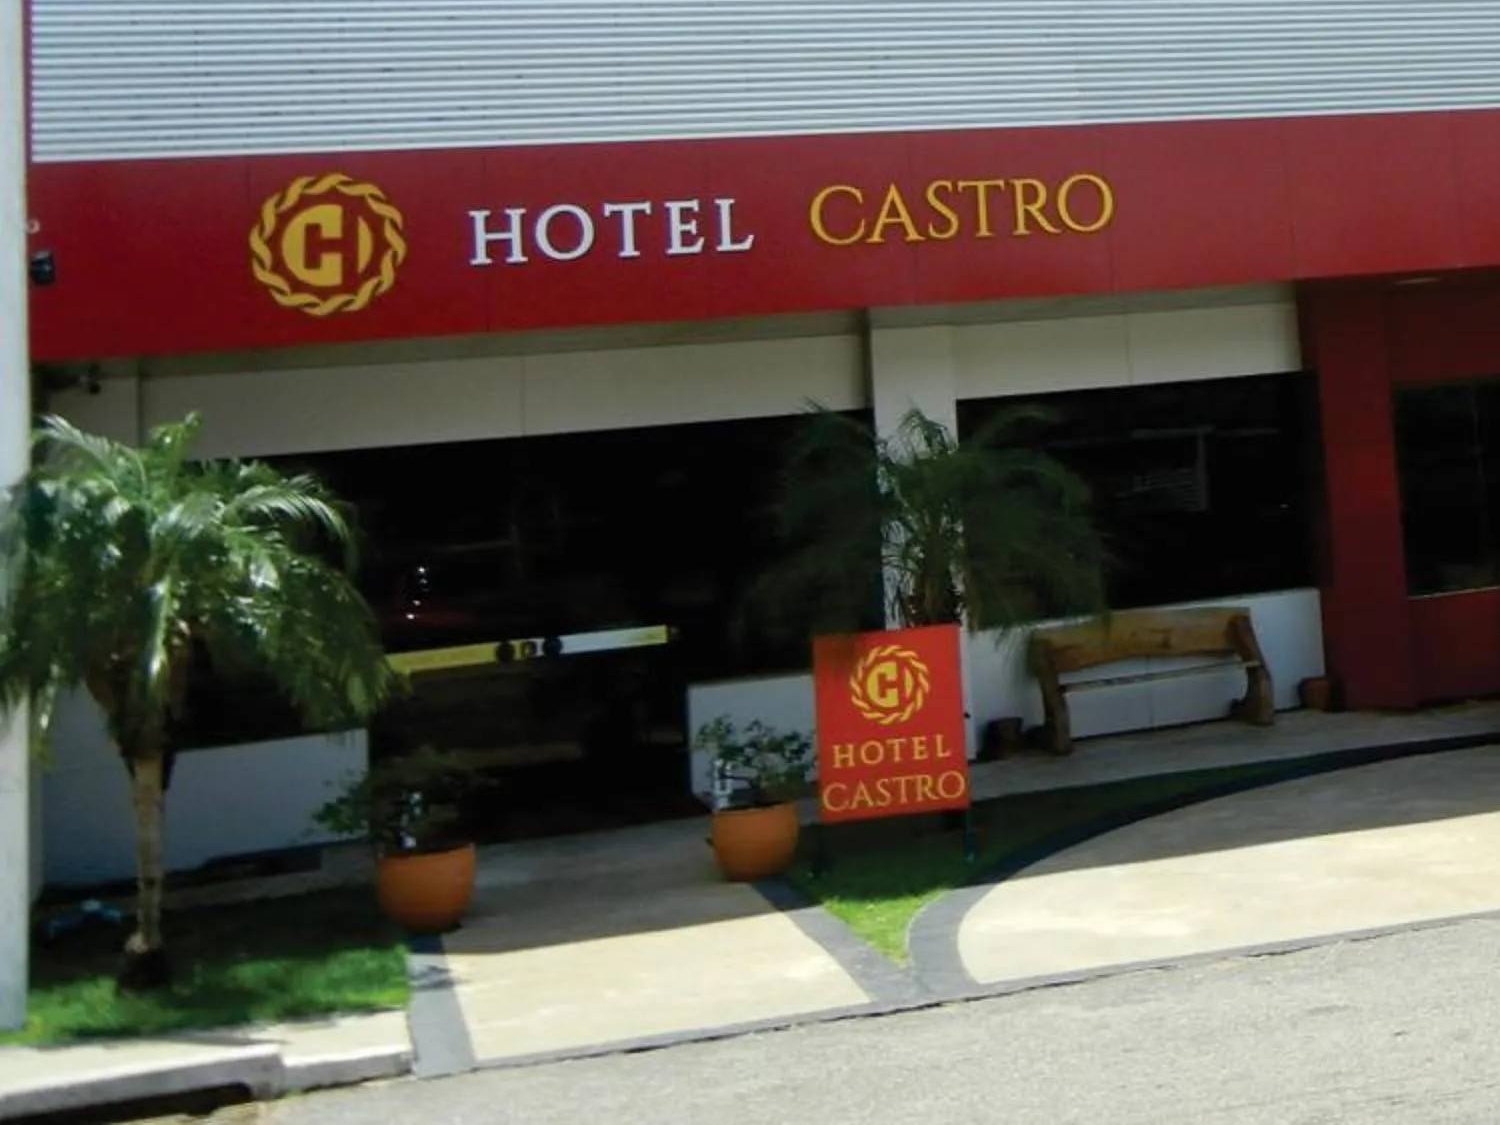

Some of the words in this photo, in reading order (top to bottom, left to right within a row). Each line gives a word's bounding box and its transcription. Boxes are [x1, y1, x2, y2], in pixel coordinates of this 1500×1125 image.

[468, 197, 755, 266] HOTEL
[810, 174, 1114, 245] CASTRO
[832, 734, 952, 769] HOTEL
[823, 770, 965, 812] CASTRO
